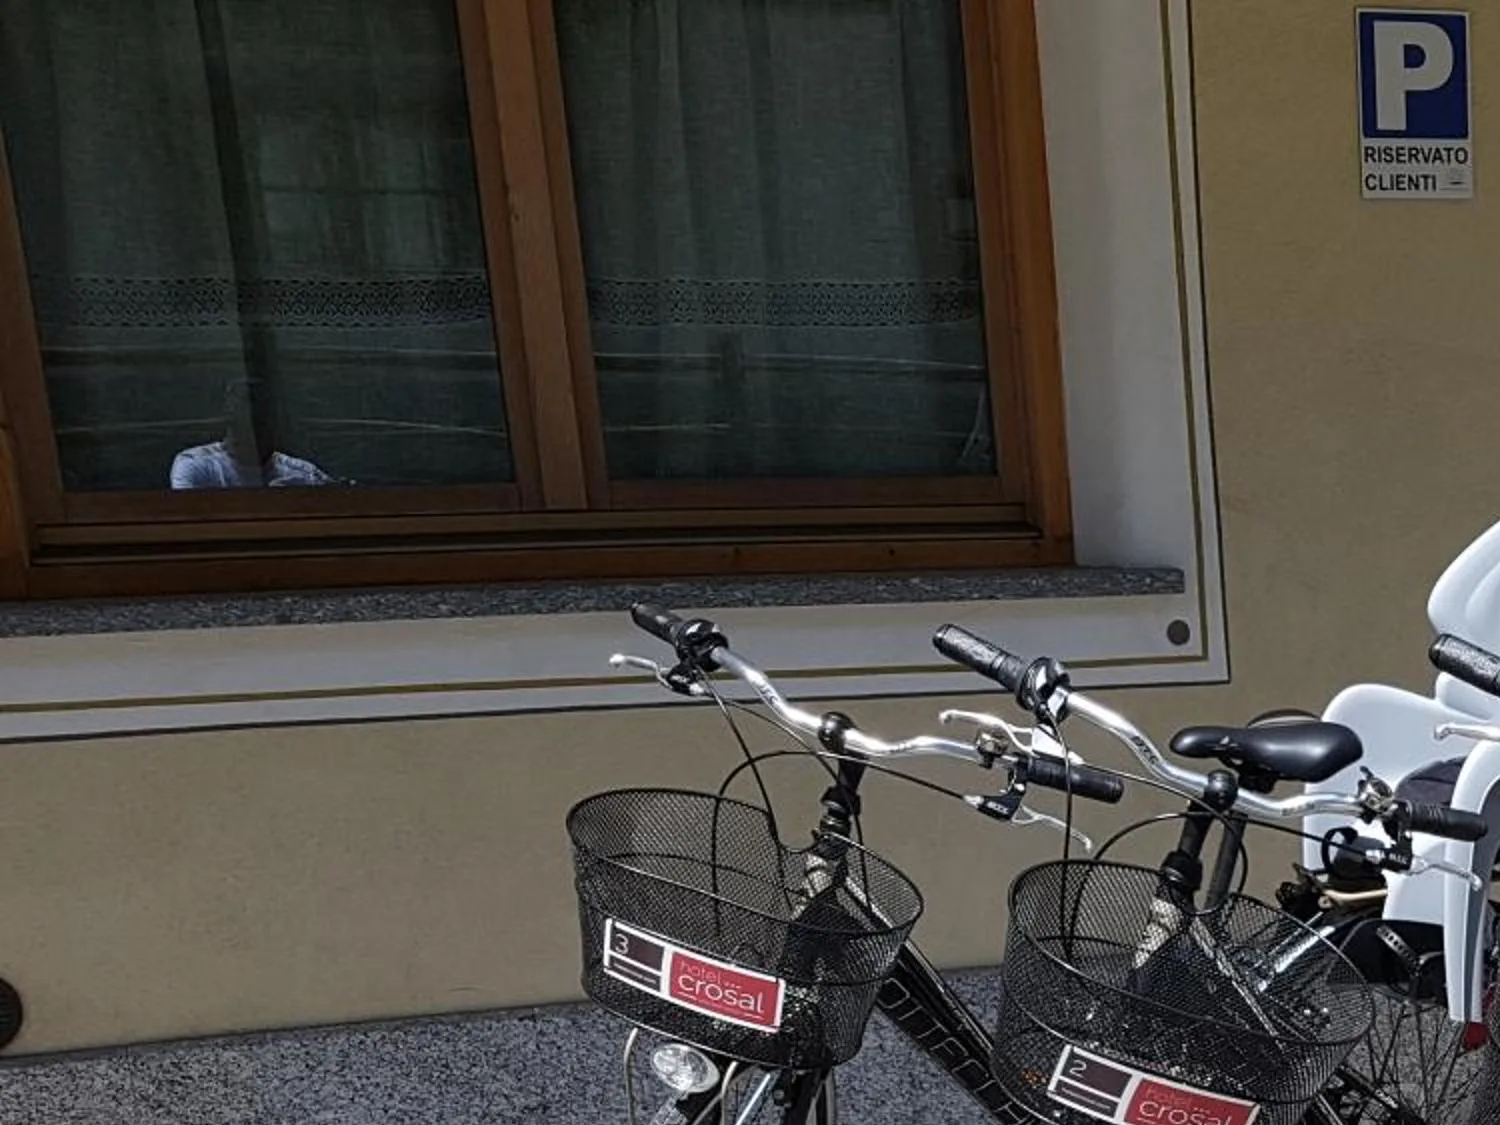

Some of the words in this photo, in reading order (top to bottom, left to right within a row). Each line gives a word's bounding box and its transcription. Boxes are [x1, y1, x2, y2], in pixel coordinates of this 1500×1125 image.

[1373, 20, 1454, 131] P
[1363, 146, 1469, 165] RISERVATO
[1364, 173, 1437, 192] CLIENTI
[614, 933, 629, 955] 3
[679, 959, 722, 985] hotel
[677, 974, 766, 1014] crosal
[1069, 1059, 1087, 1078] 2
